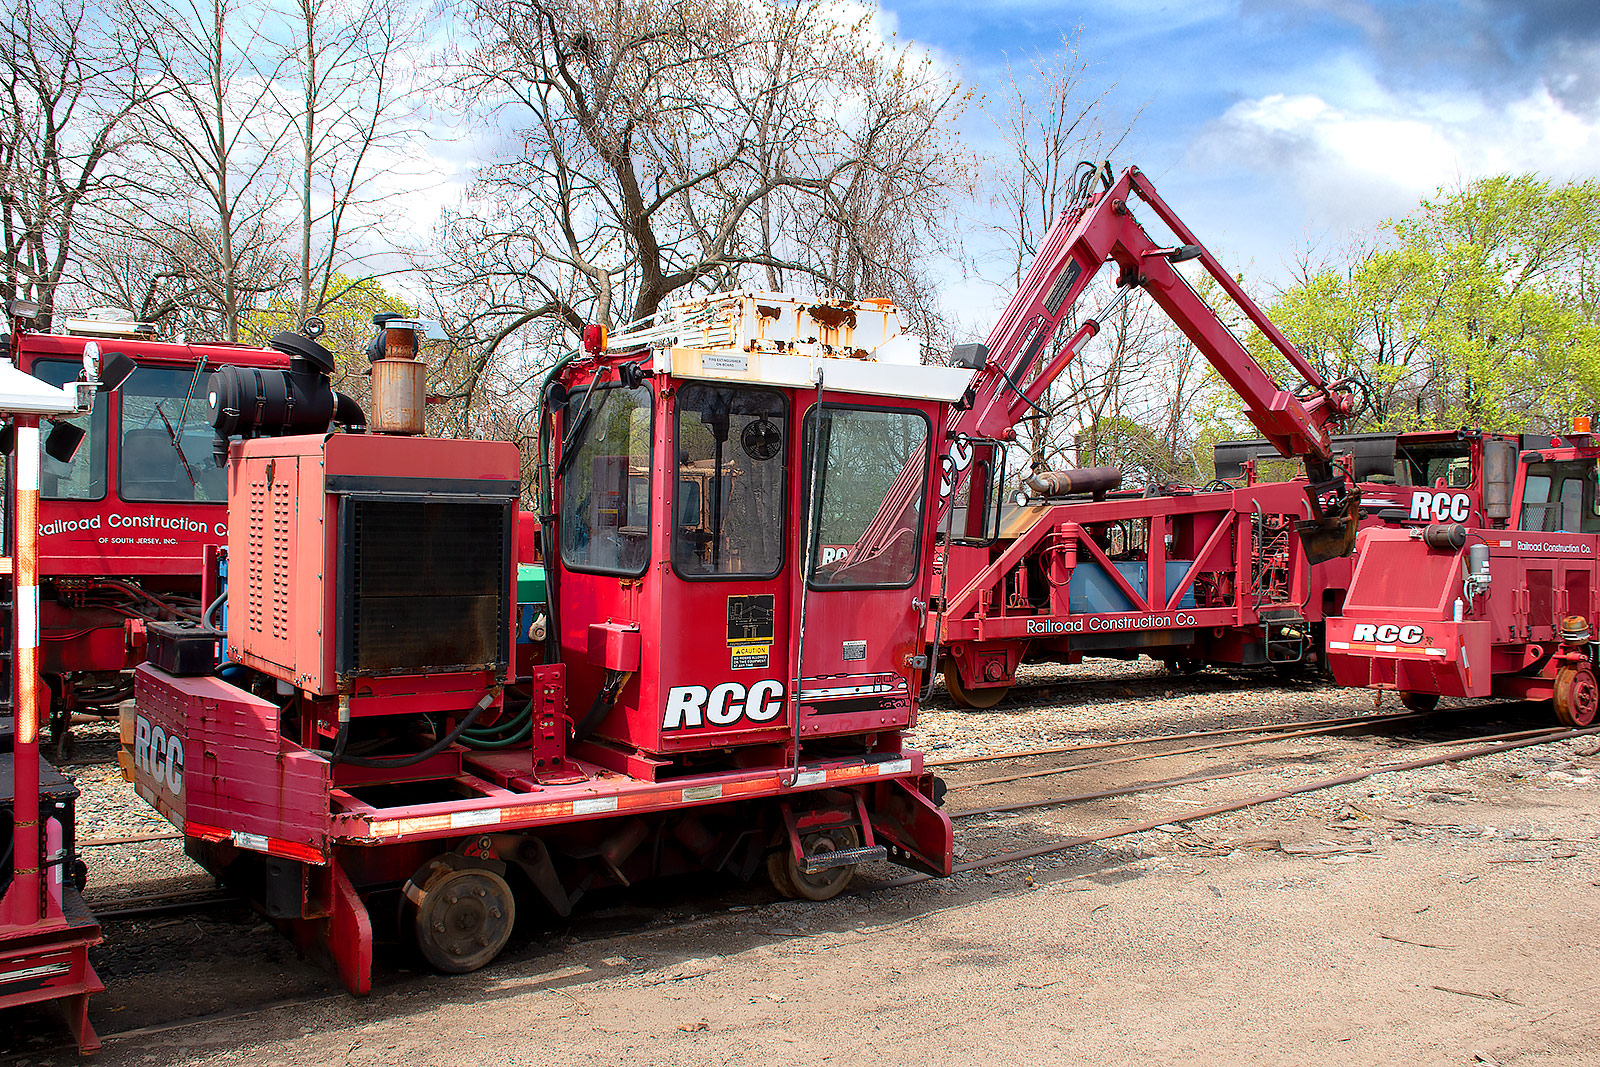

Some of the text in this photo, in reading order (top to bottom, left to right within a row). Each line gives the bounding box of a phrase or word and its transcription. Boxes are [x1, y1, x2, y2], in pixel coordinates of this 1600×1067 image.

[1409, 491, 1471, 523] RCC
[108, 513, 208, 534] Construction
[214, 522, 230, 537] C
[111, 537, 134, 545] SOUTH
[136, 537, 162, 545] JERSEY,
[1517, 540, 1592, 554] Railroad Construction Co.
[1026, 612, 1198, 634] Railroad Construction Co.
[1352, 623, 1424, 643] RCC
[661, 679, 784, 732] RCC
[135, 714, 184, 795] RCC
